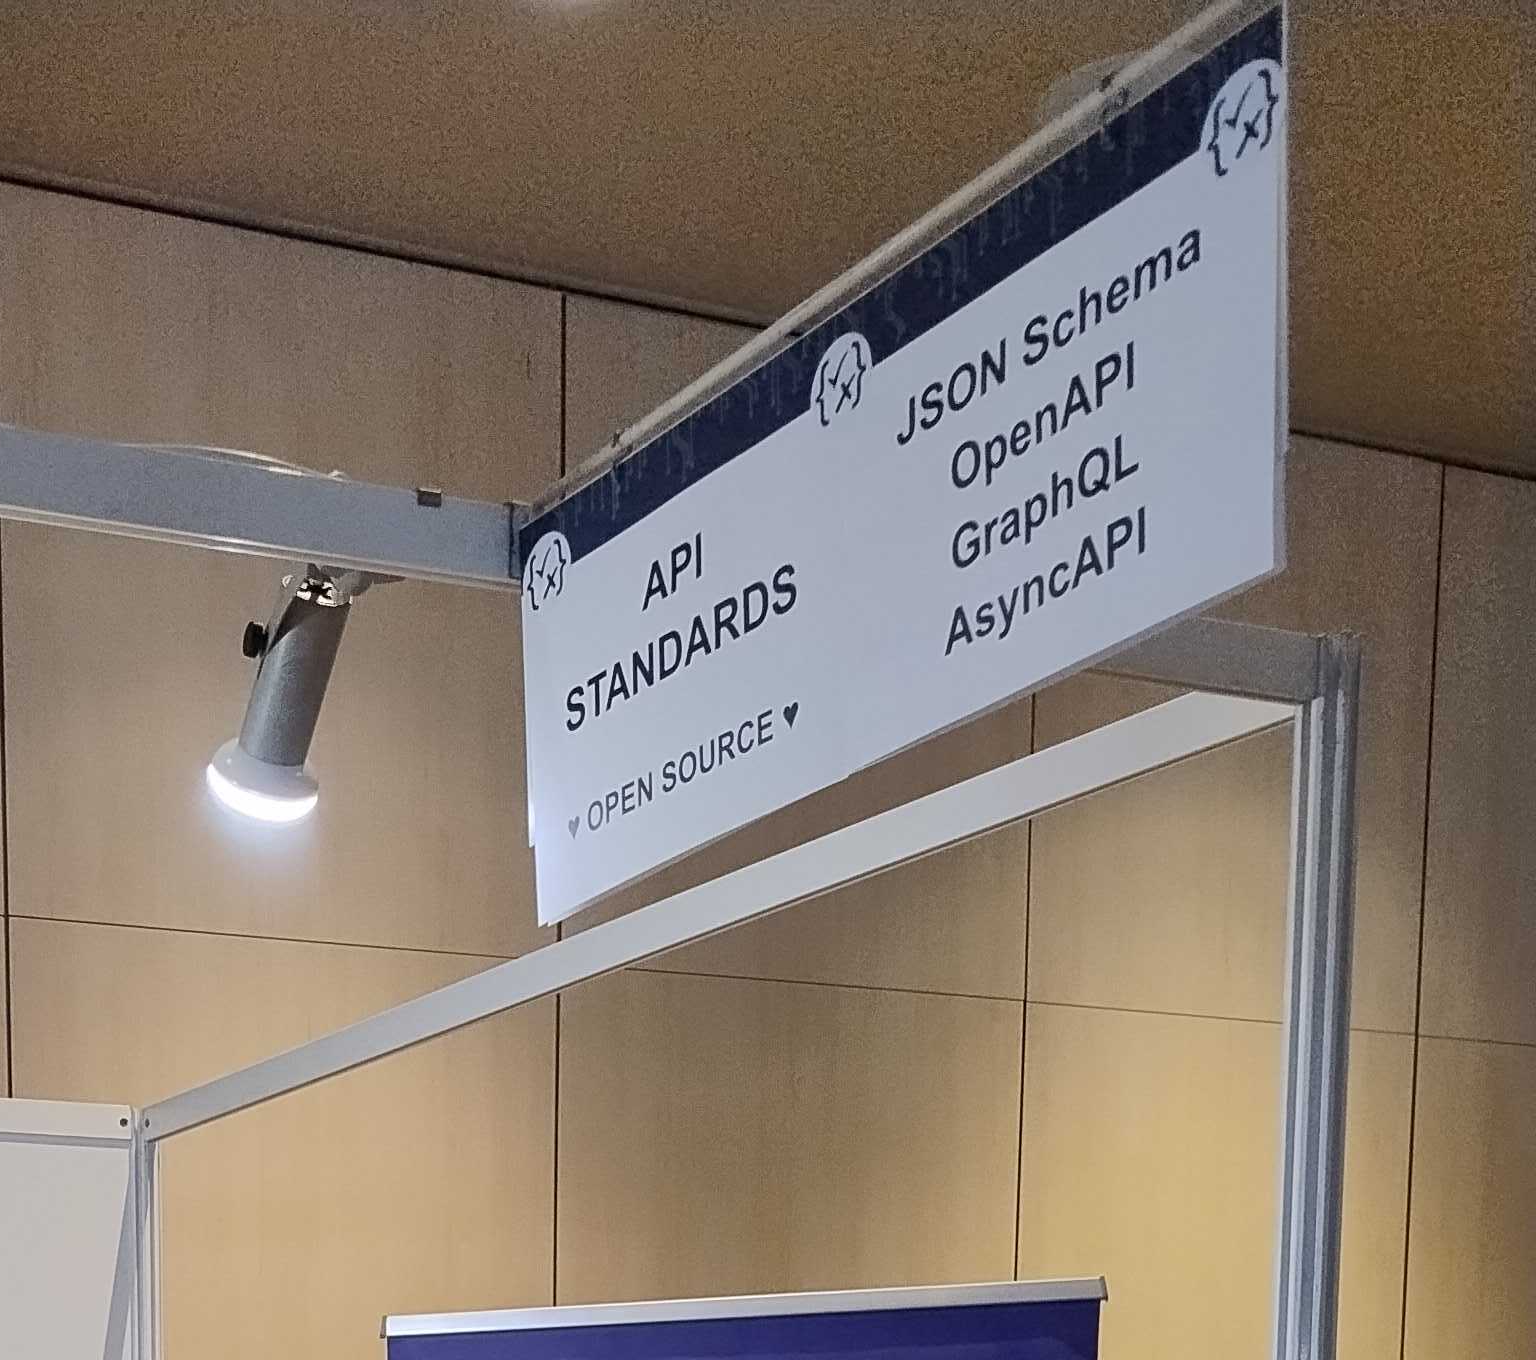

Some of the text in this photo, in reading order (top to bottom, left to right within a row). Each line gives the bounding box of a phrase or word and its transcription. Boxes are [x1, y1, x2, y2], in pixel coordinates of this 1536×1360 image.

[896, 228, 1202, 446] JSON Schema
[951, 340, 1135, 489] OpenAPI
[641, 531, 703, 612] API
[951, 433, 1140, 571] GraphQL
[565, 563, 798, 732] STANDARDS
[943, 505, 1146, 657] AsyncAPI
[586, 708, 774, 833] OPEN SOURCE
